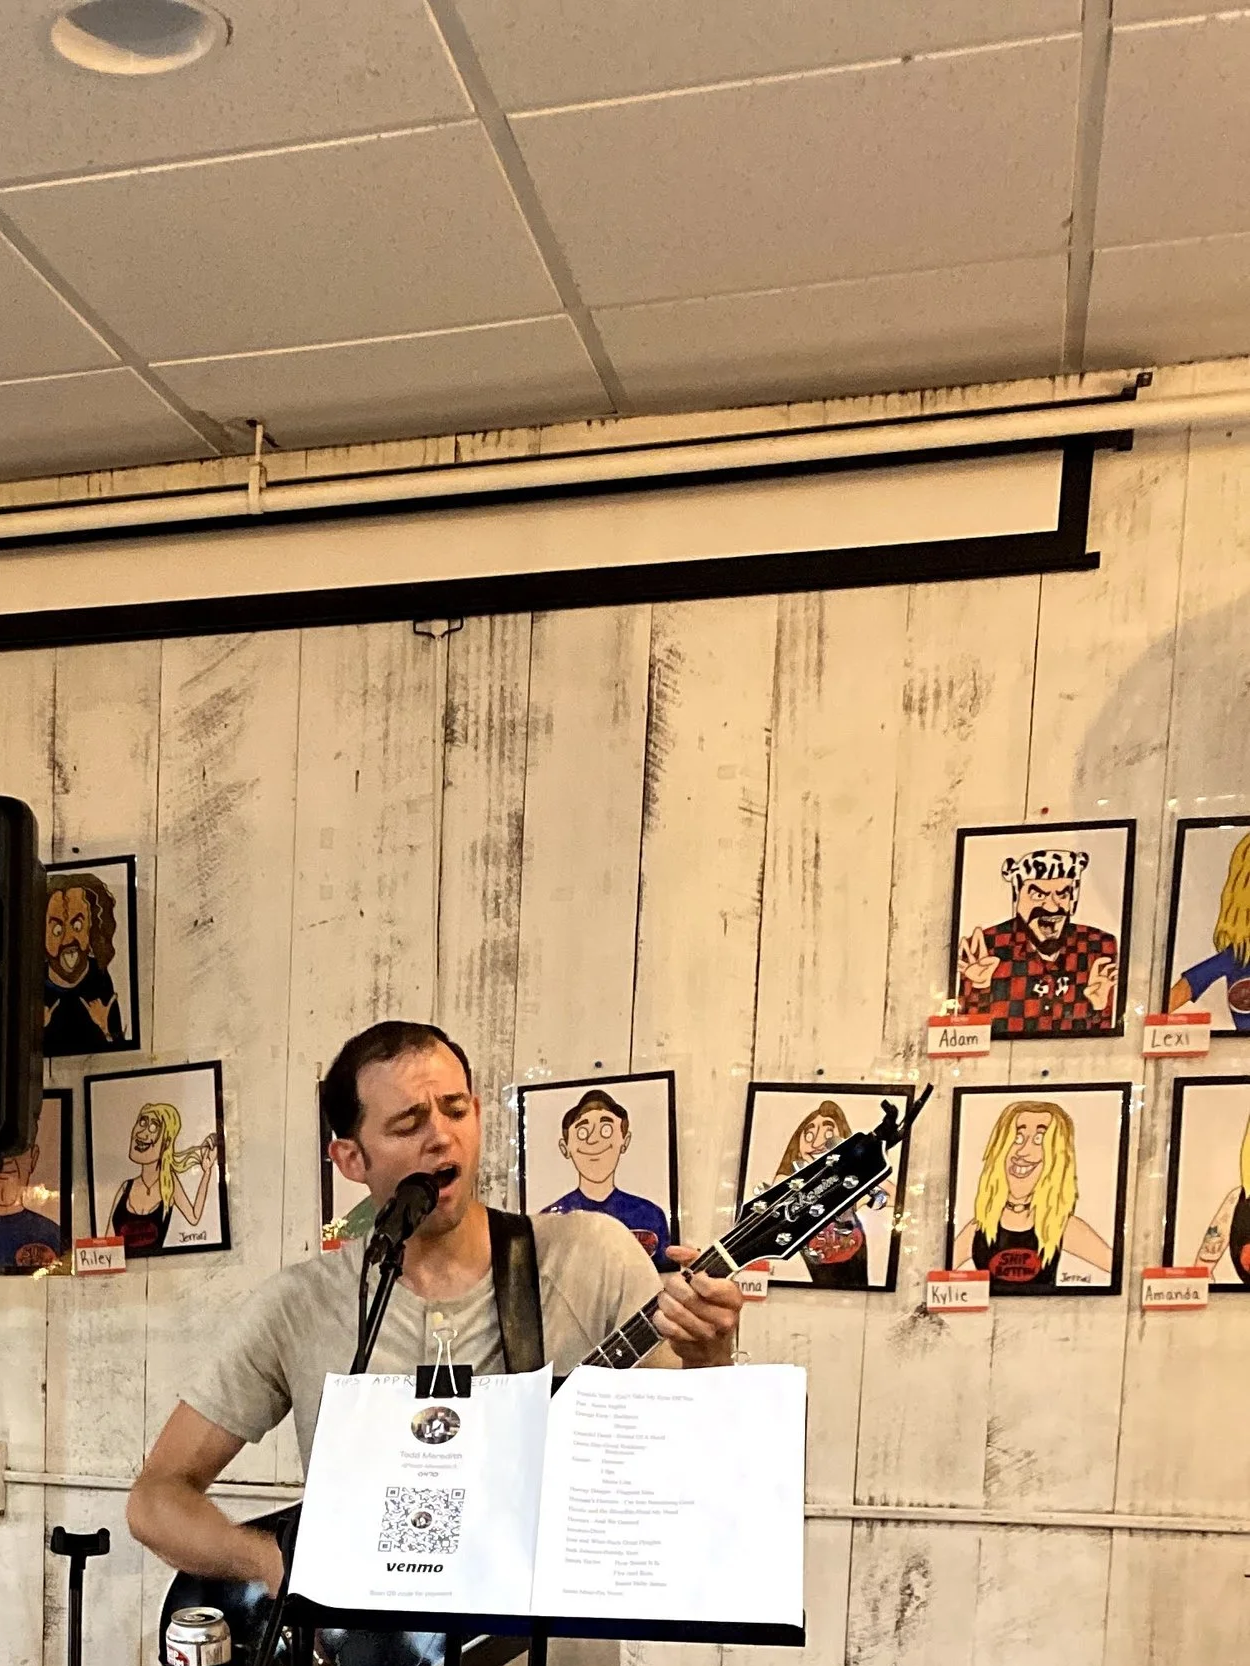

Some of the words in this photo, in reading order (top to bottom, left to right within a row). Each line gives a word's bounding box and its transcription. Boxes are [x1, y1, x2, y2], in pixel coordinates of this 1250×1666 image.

[939, 1030, 979, 1048] Adam
[1151, 1029, 1190, 1048] Lexi
[80, 1250, 112, 1268] Riley
[738, 1280, 763, 1292] nna
[931, 1285, 969, 1304] Kylie
[1145, 1285, 1201, 1301] Amanda
[387, 1562, 444, 1573] venmo
